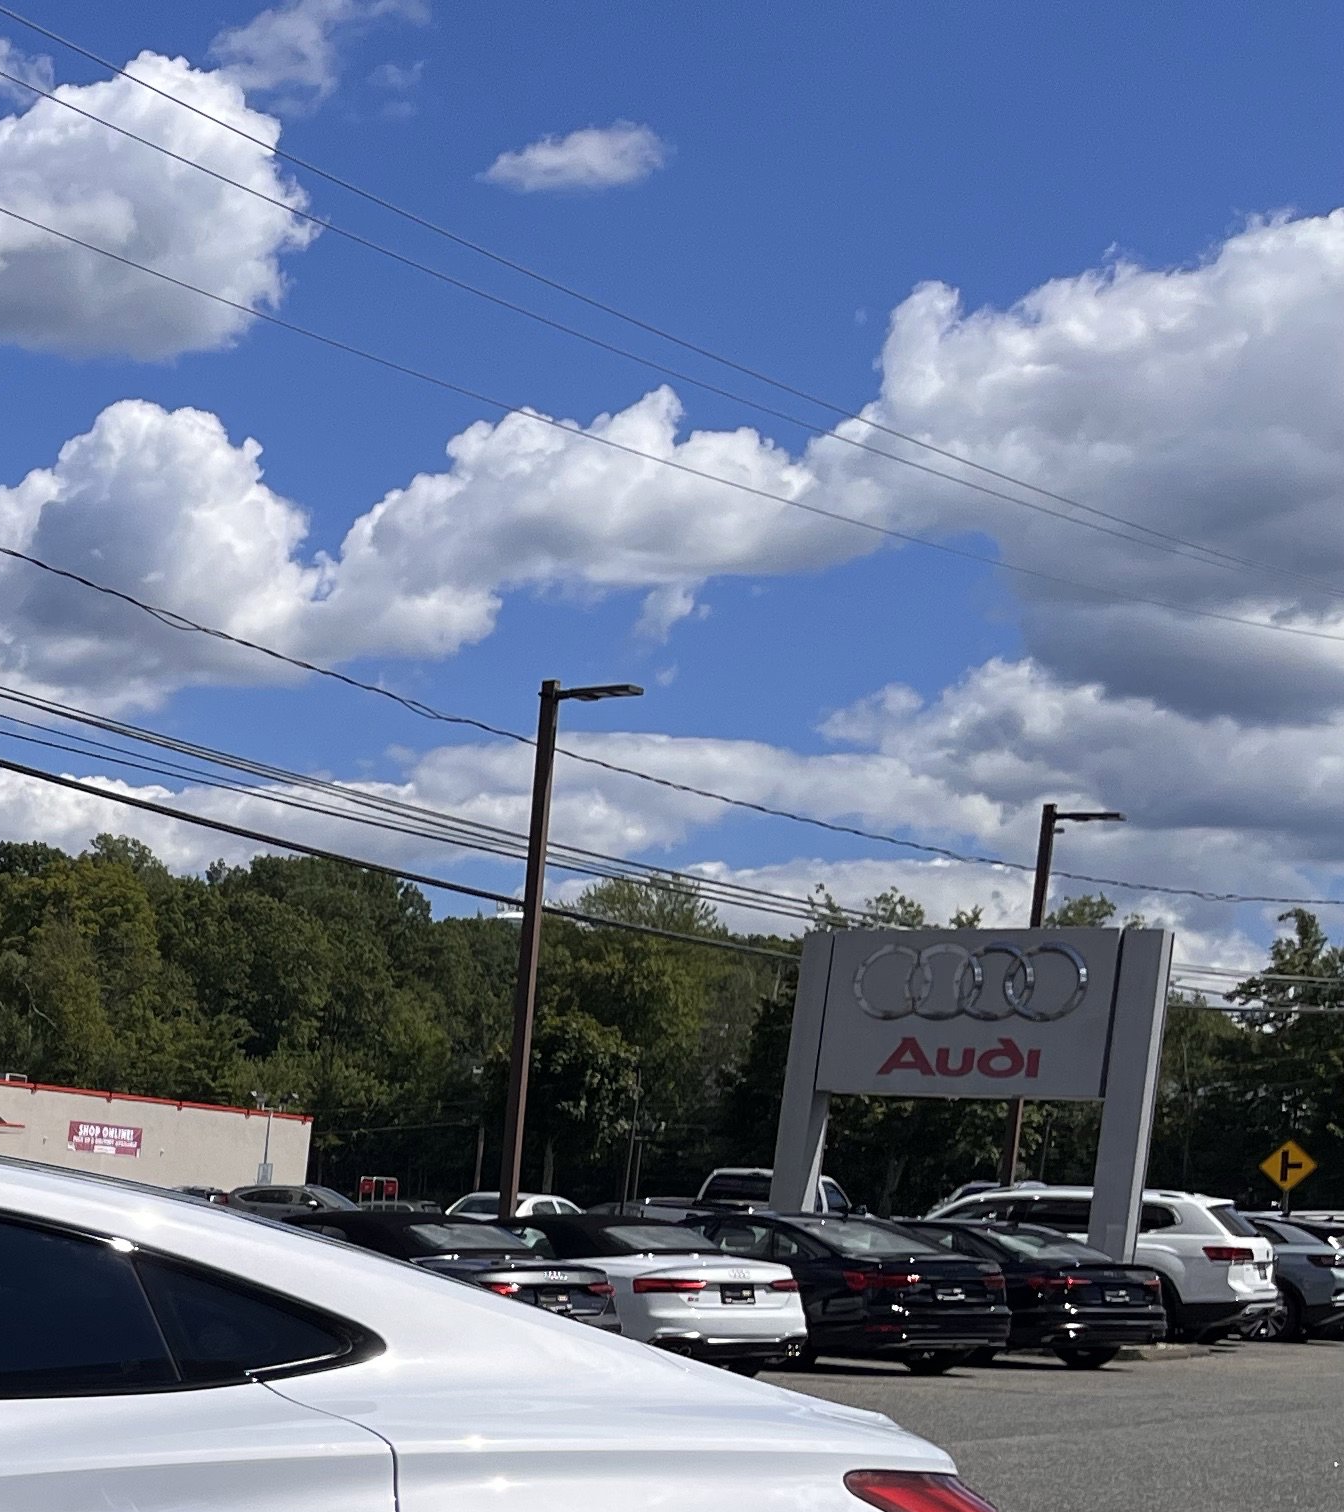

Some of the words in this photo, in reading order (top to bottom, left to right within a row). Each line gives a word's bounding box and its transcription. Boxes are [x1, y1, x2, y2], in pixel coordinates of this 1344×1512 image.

[876, 1036, 1042, 1079] Audi
[78, 1124, 101, 1137] SHOP
[101, 1127, 134, 1141] ONLINE!
